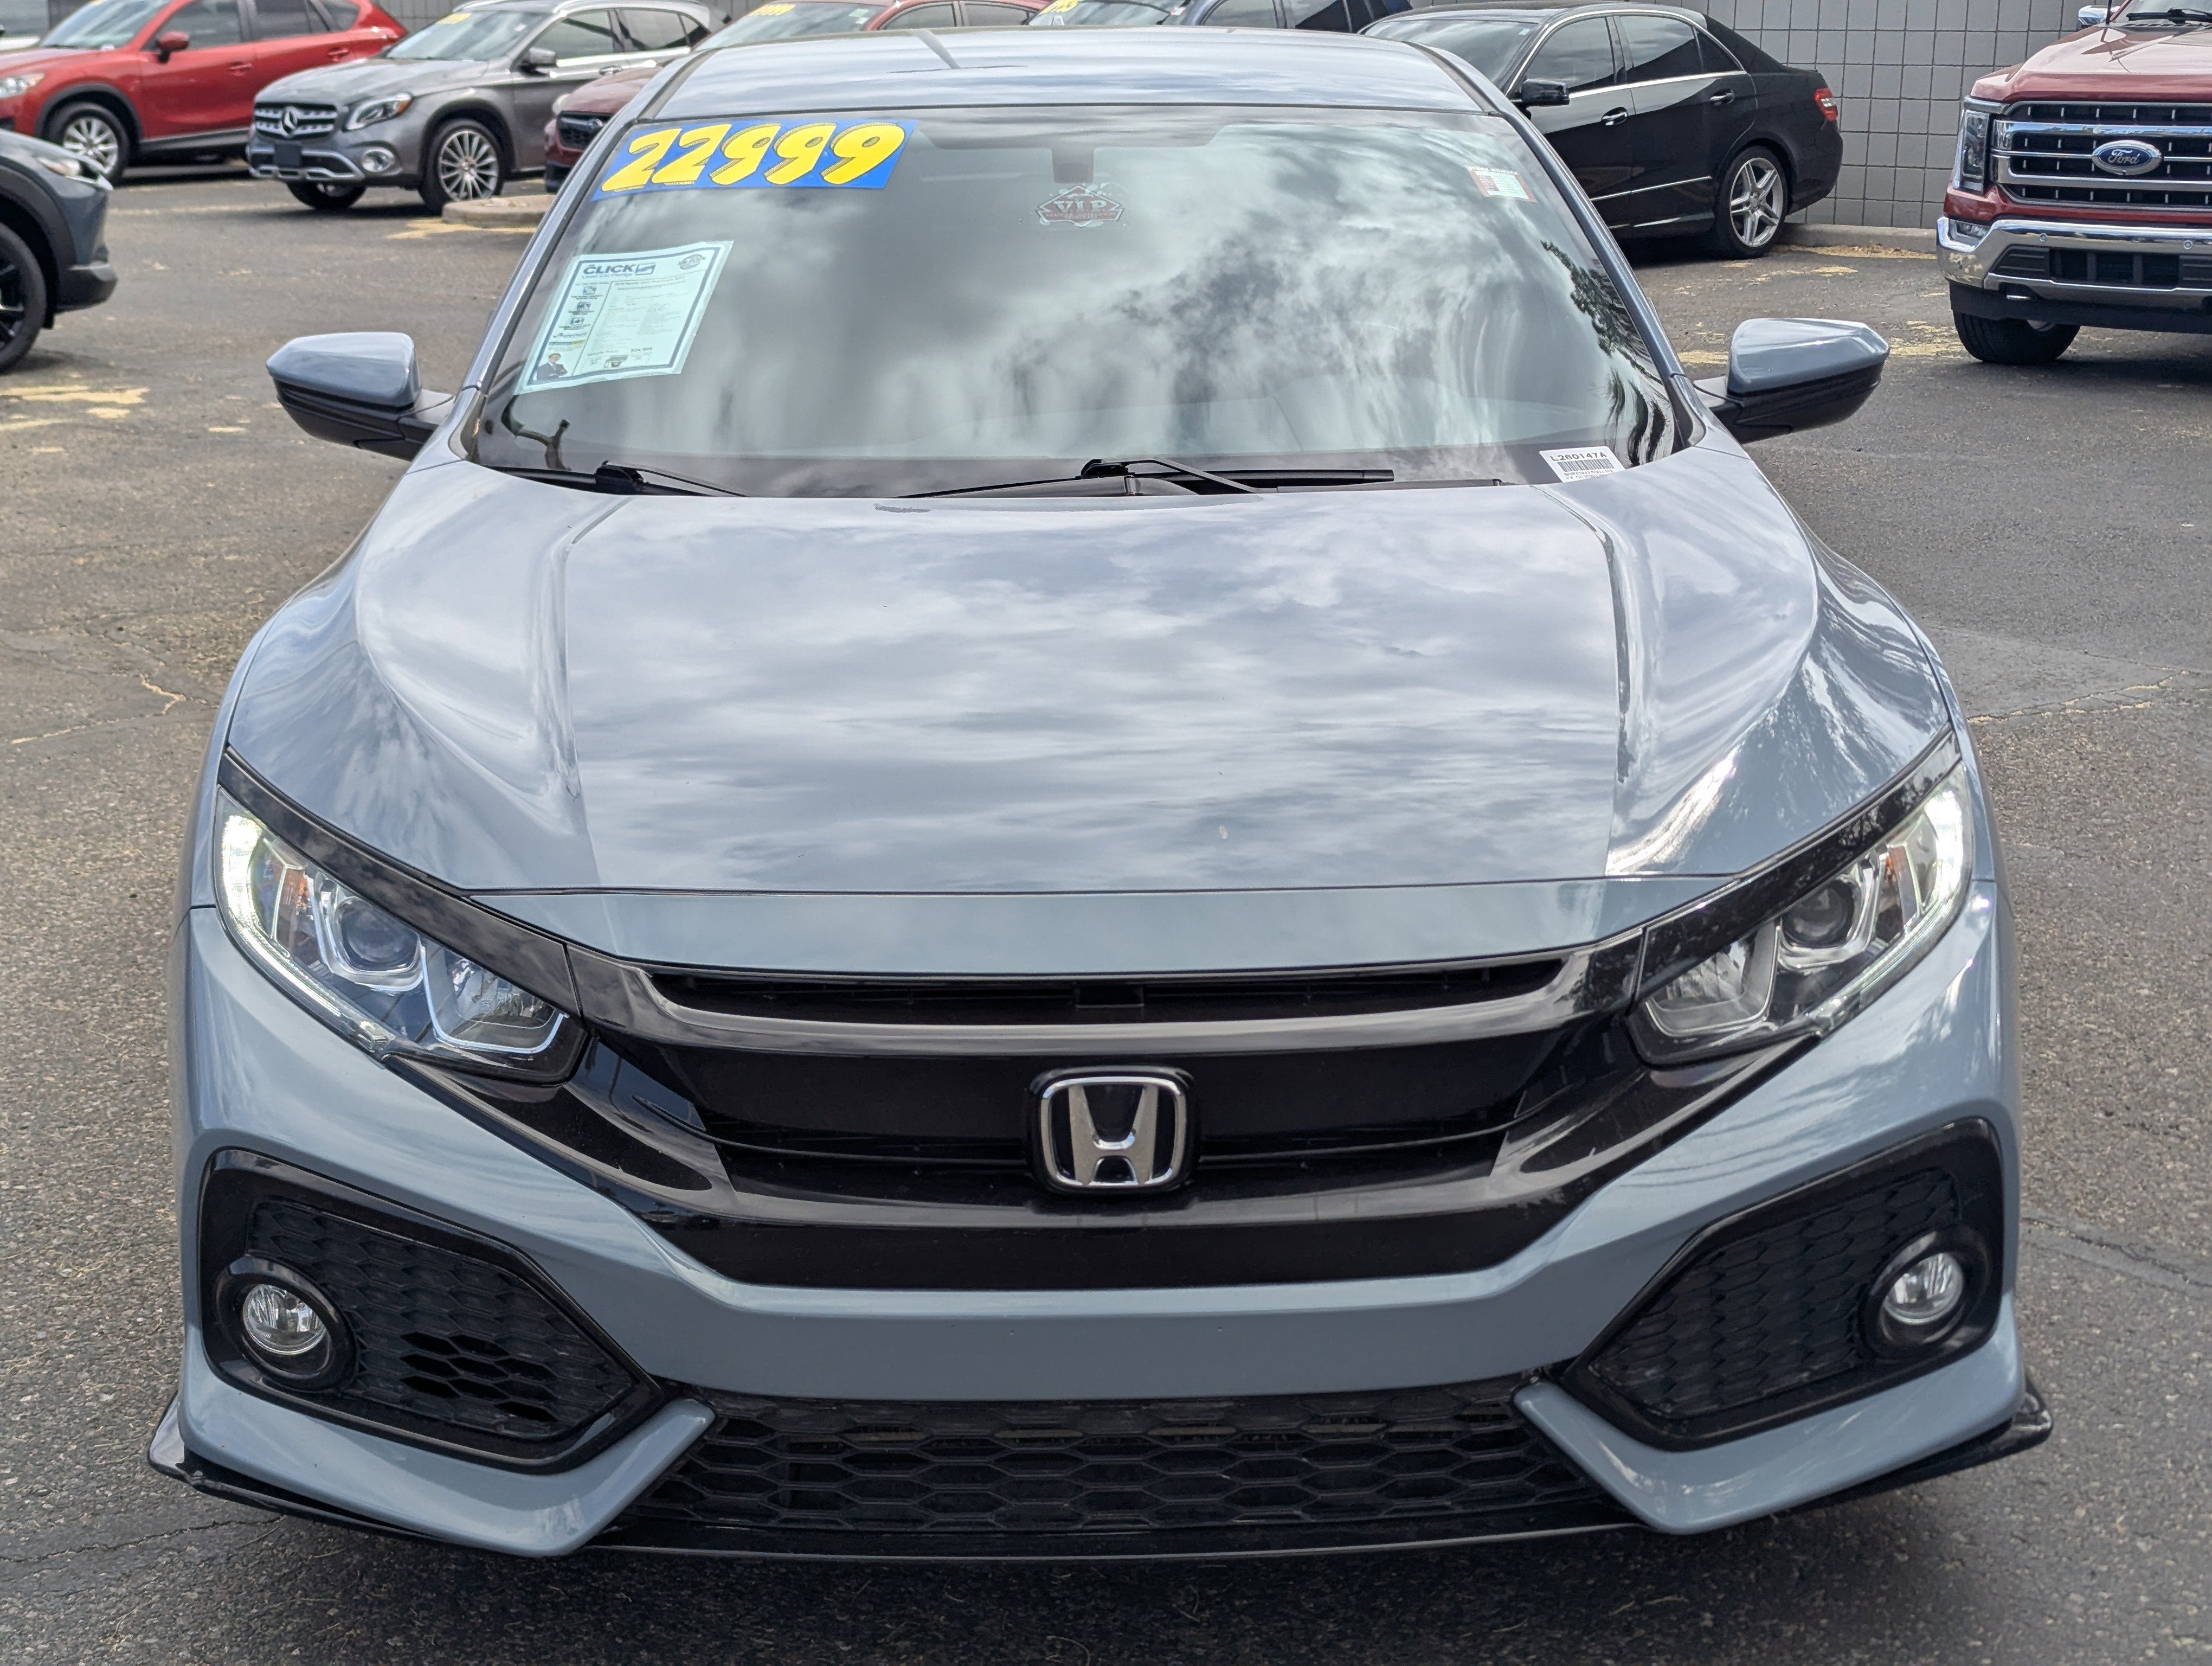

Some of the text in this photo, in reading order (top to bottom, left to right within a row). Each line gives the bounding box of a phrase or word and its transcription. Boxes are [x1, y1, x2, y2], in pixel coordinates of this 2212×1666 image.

[601, 121, 905, 191] 22999
[2108, 149, 2140, 164] Ford
[1053, 200, 1107, 212] VIP
[583, 265, 635, 275] CLICK
